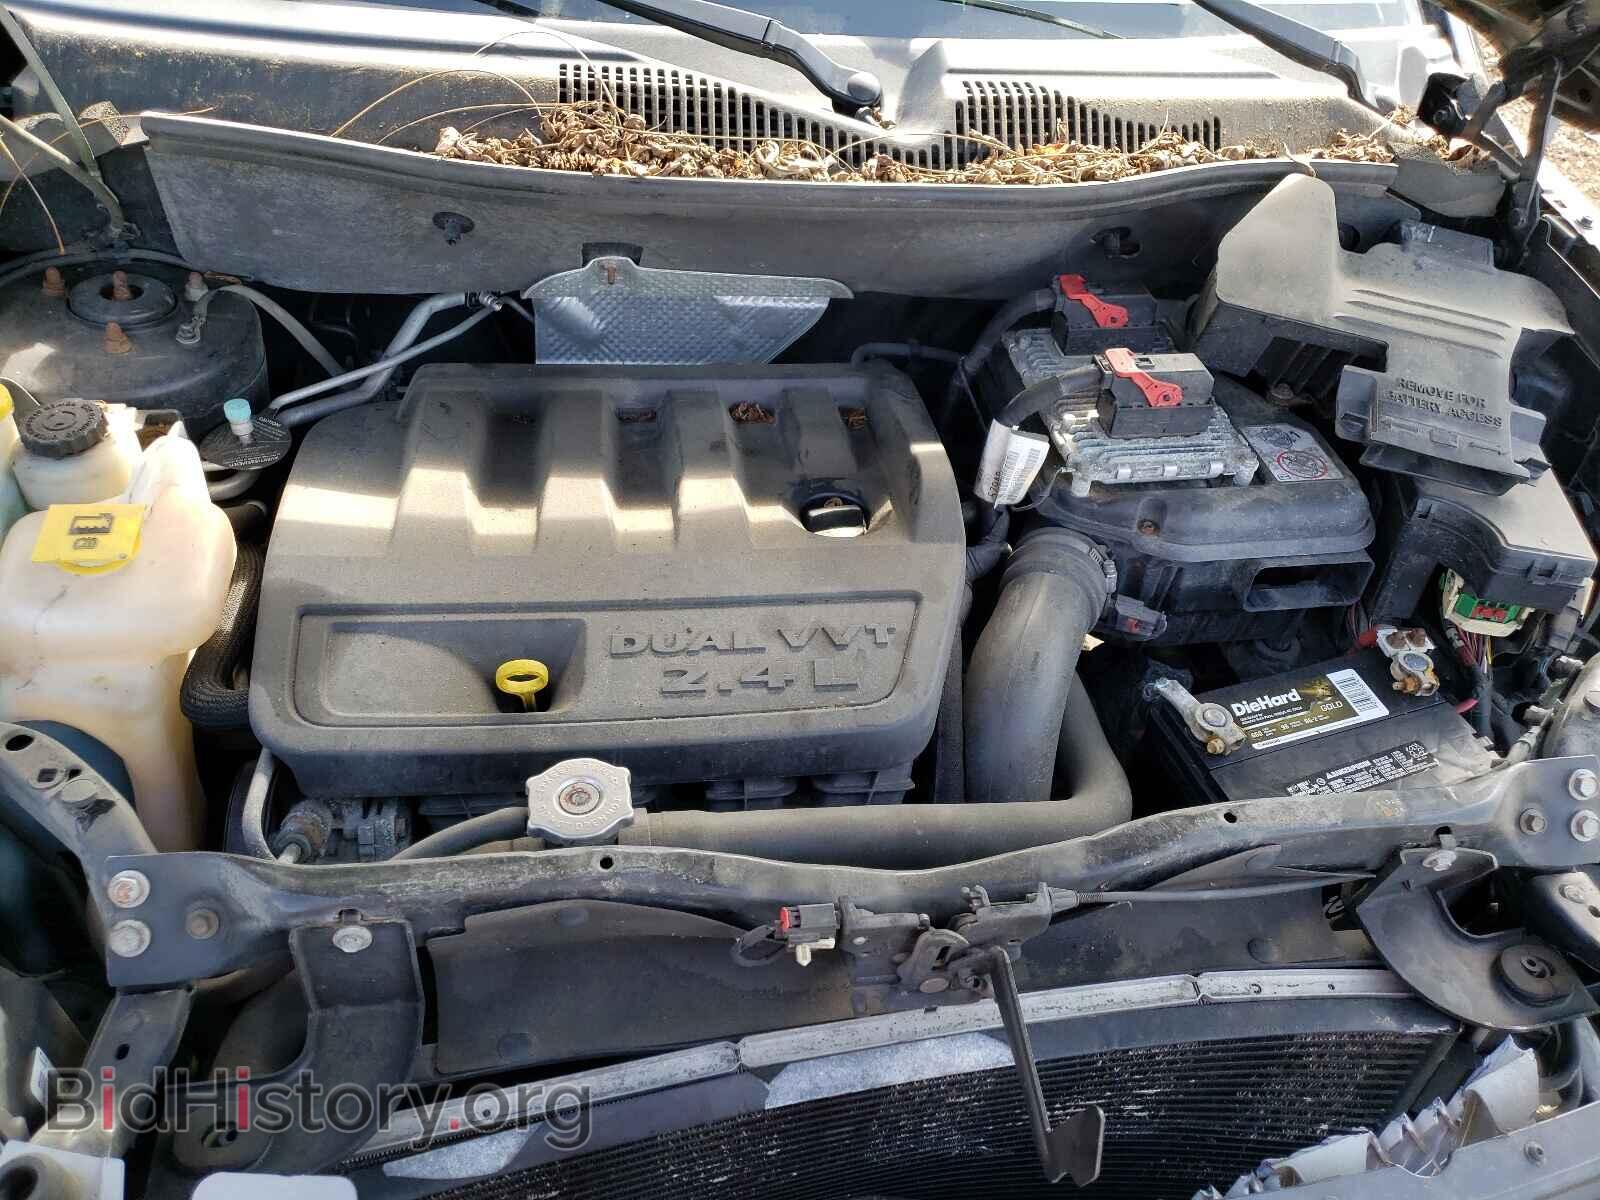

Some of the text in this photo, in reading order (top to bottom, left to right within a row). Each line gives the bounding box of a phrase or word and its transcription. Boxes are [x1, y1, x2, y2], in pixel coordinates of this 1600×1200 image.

[1386, 390, 1503, 427] BATTERY ACCESS
[1398, 377, 1487, 409] REMOVE FOR
[610, 622, 897, 659] DUAL VVT
[1231, 689, 1302, 716] DieHard
[1320, 701, 1344, 712] GOLD
